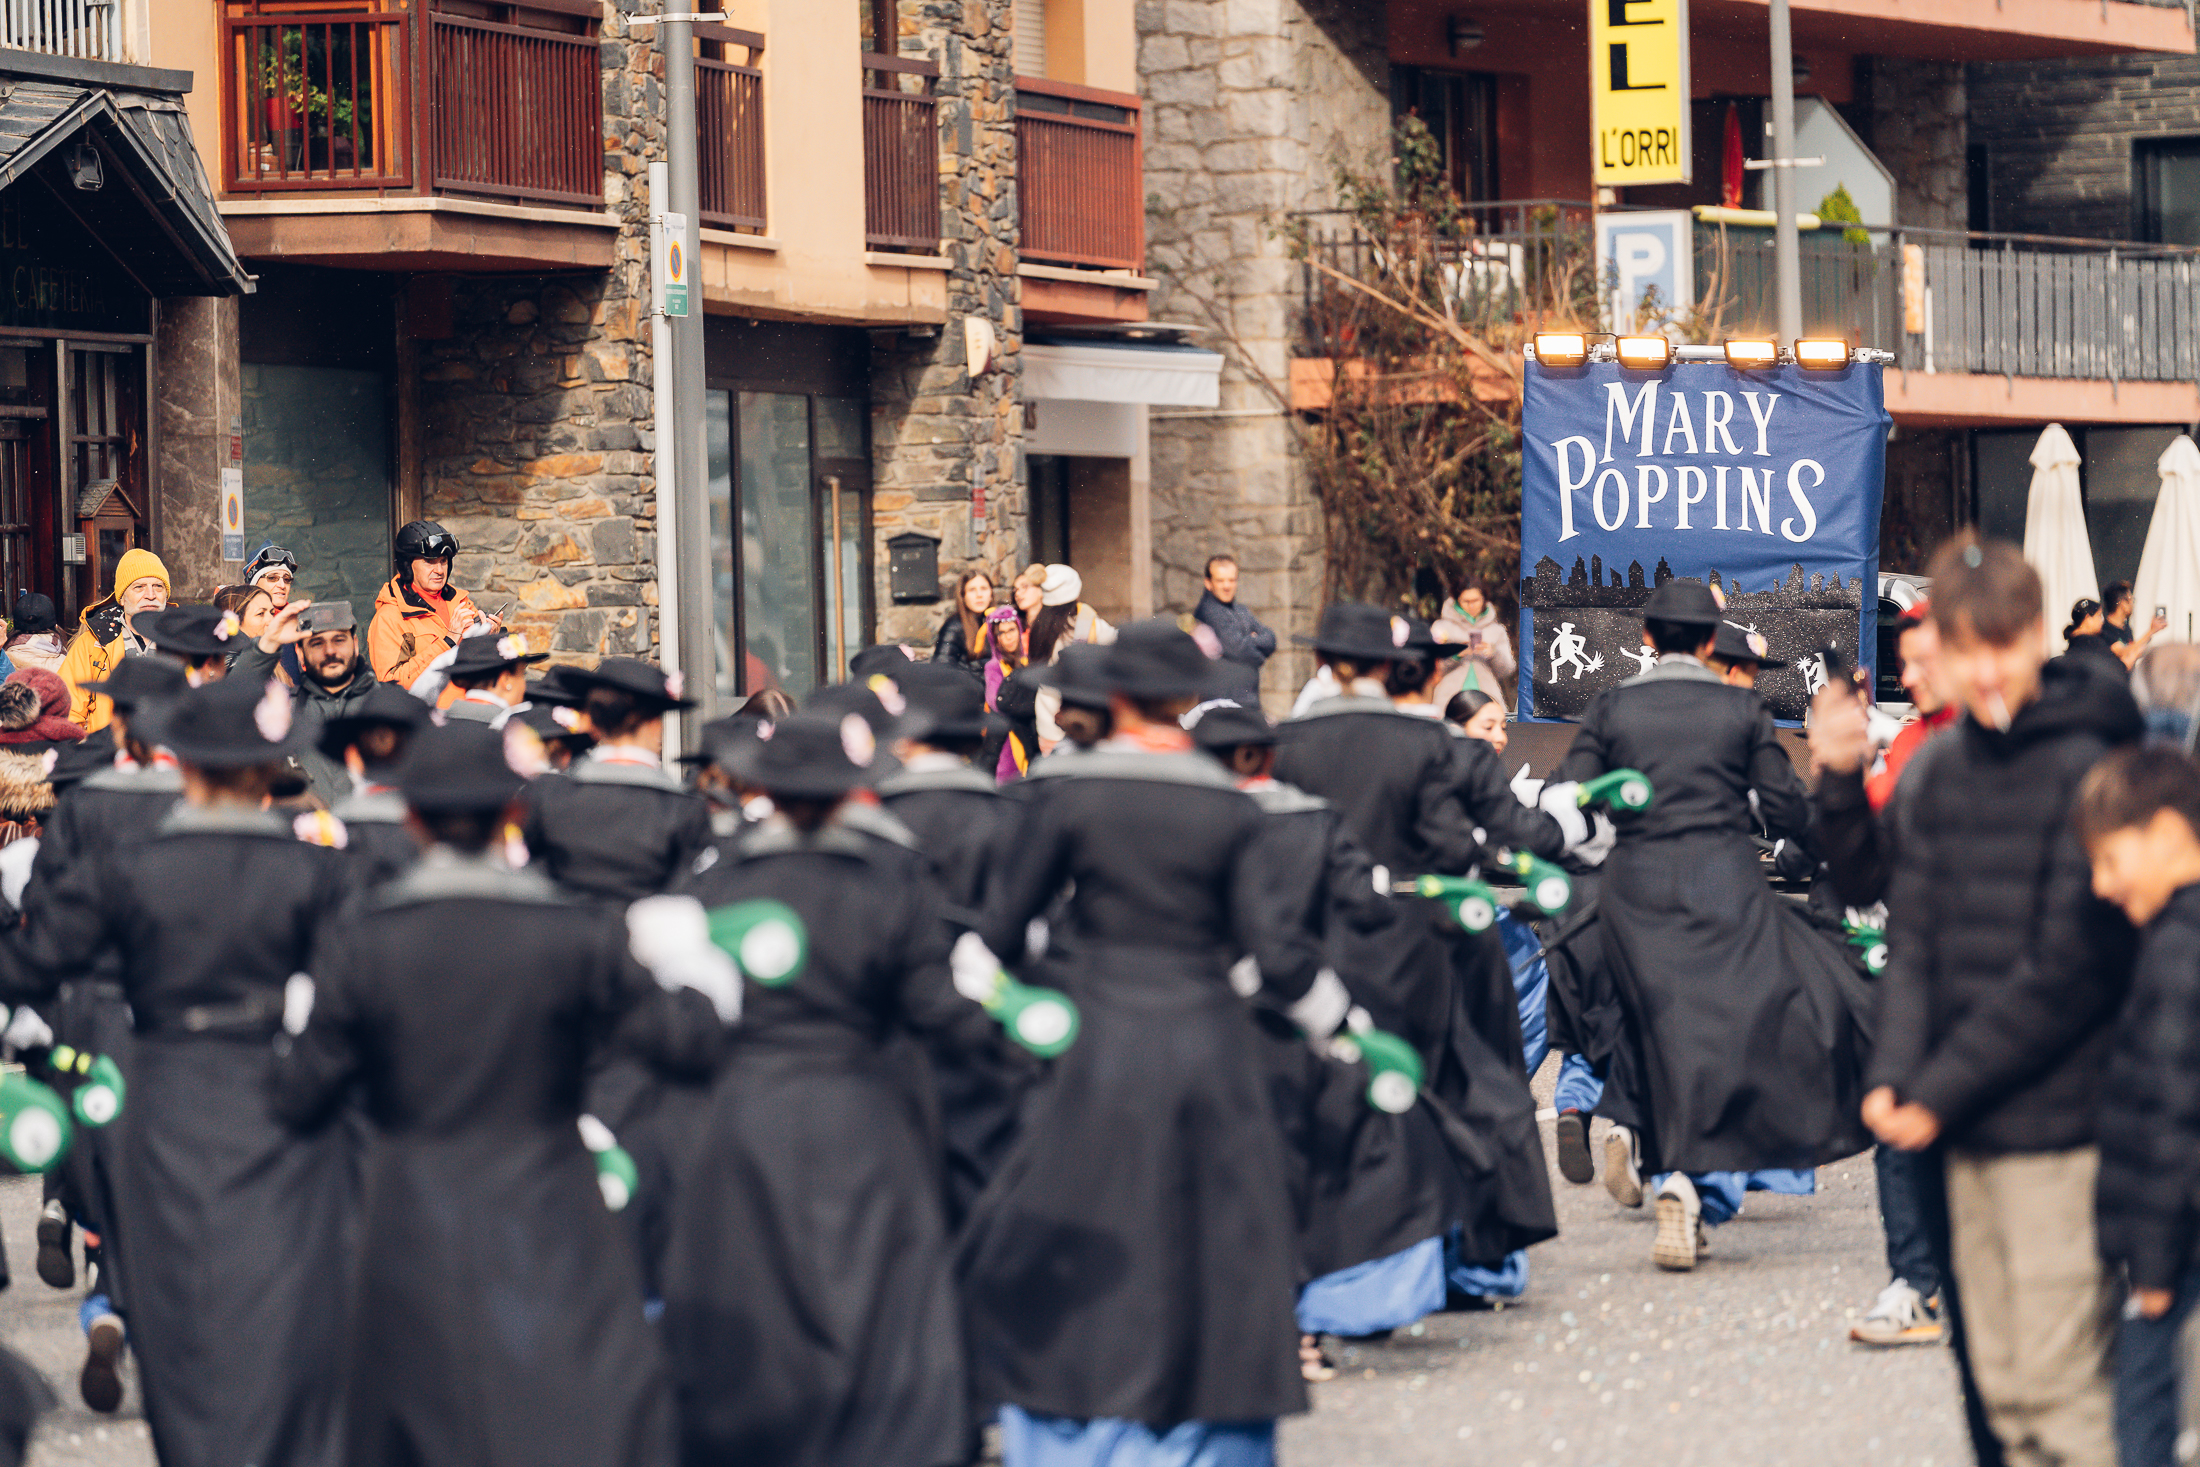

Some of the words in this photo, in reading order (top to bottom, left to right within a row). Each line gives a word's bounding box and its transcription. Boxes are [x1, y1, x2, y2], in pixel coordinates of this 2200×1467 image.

[1601, 127, 1678, 168] L'ORRI
[13, 266, 105, 313] CAFETERIA
[1616, 233, 1665, 325] P
